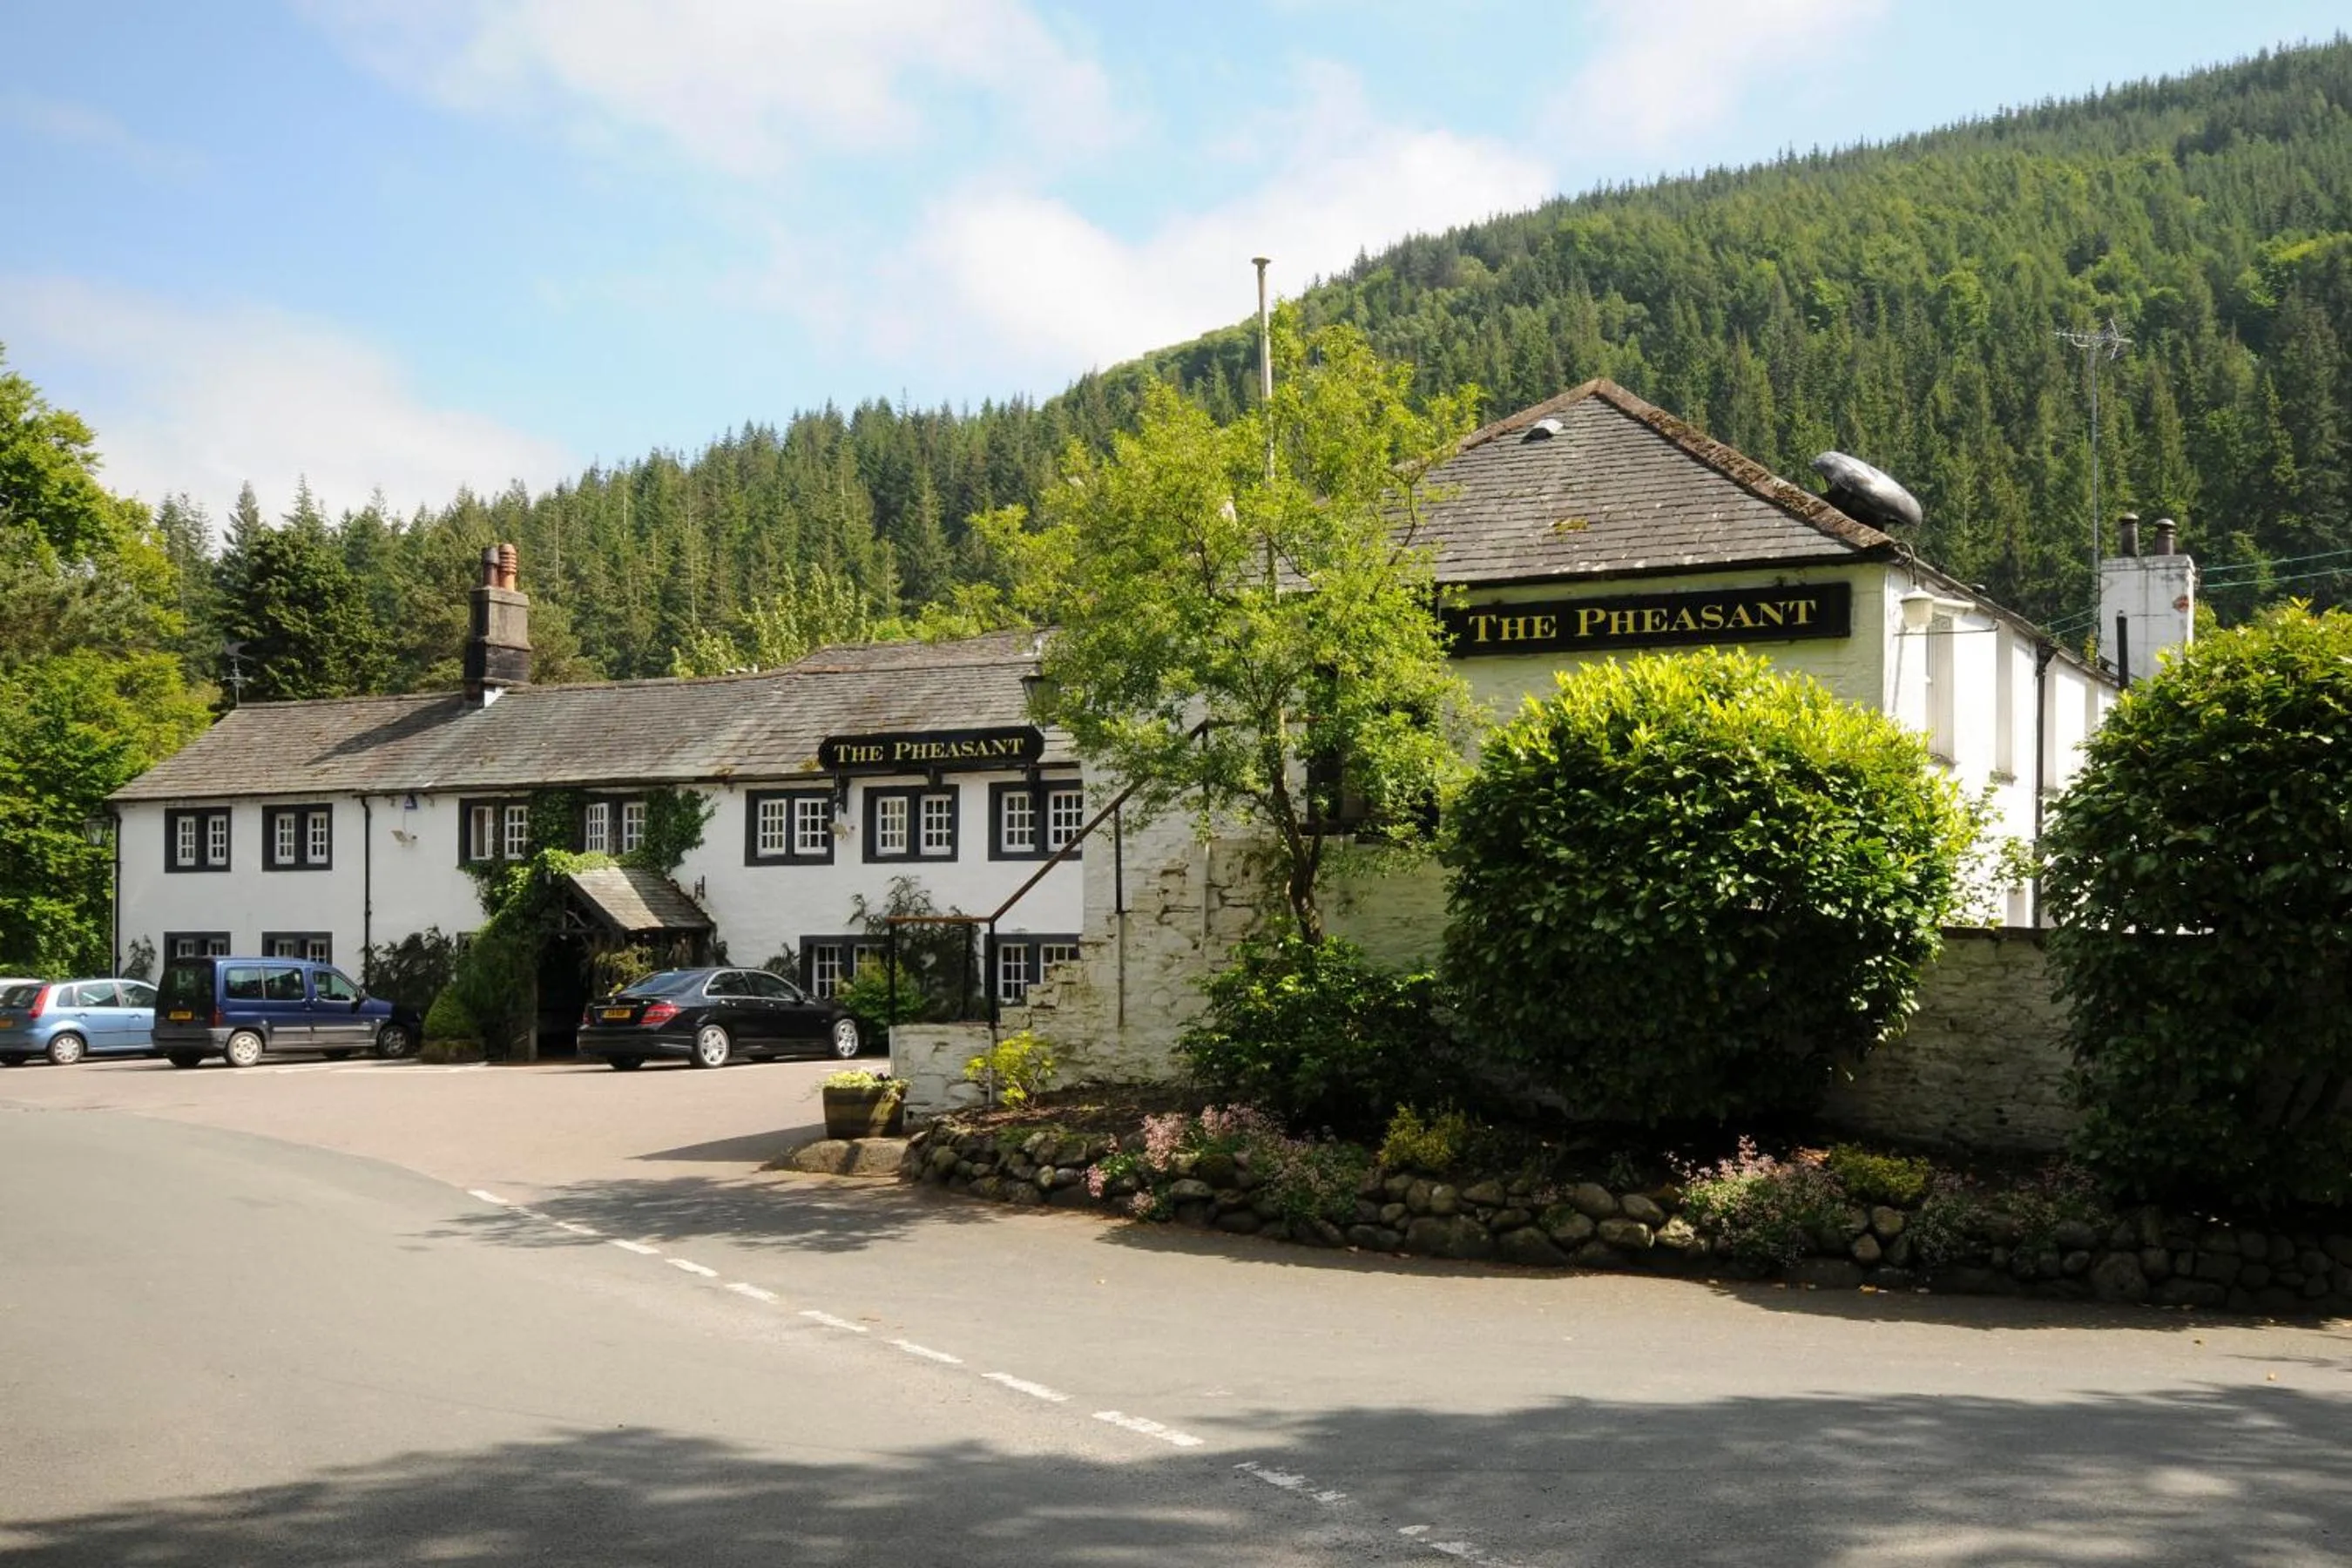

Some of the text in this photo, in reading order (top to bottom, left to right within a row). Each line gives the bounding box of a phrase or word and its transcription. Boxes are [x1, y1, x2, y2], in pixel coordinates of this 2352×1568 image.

[1469, 599, 1816, 642] THE PHEASANT
[834, 738, 1024, 762] THE PHEASANT
